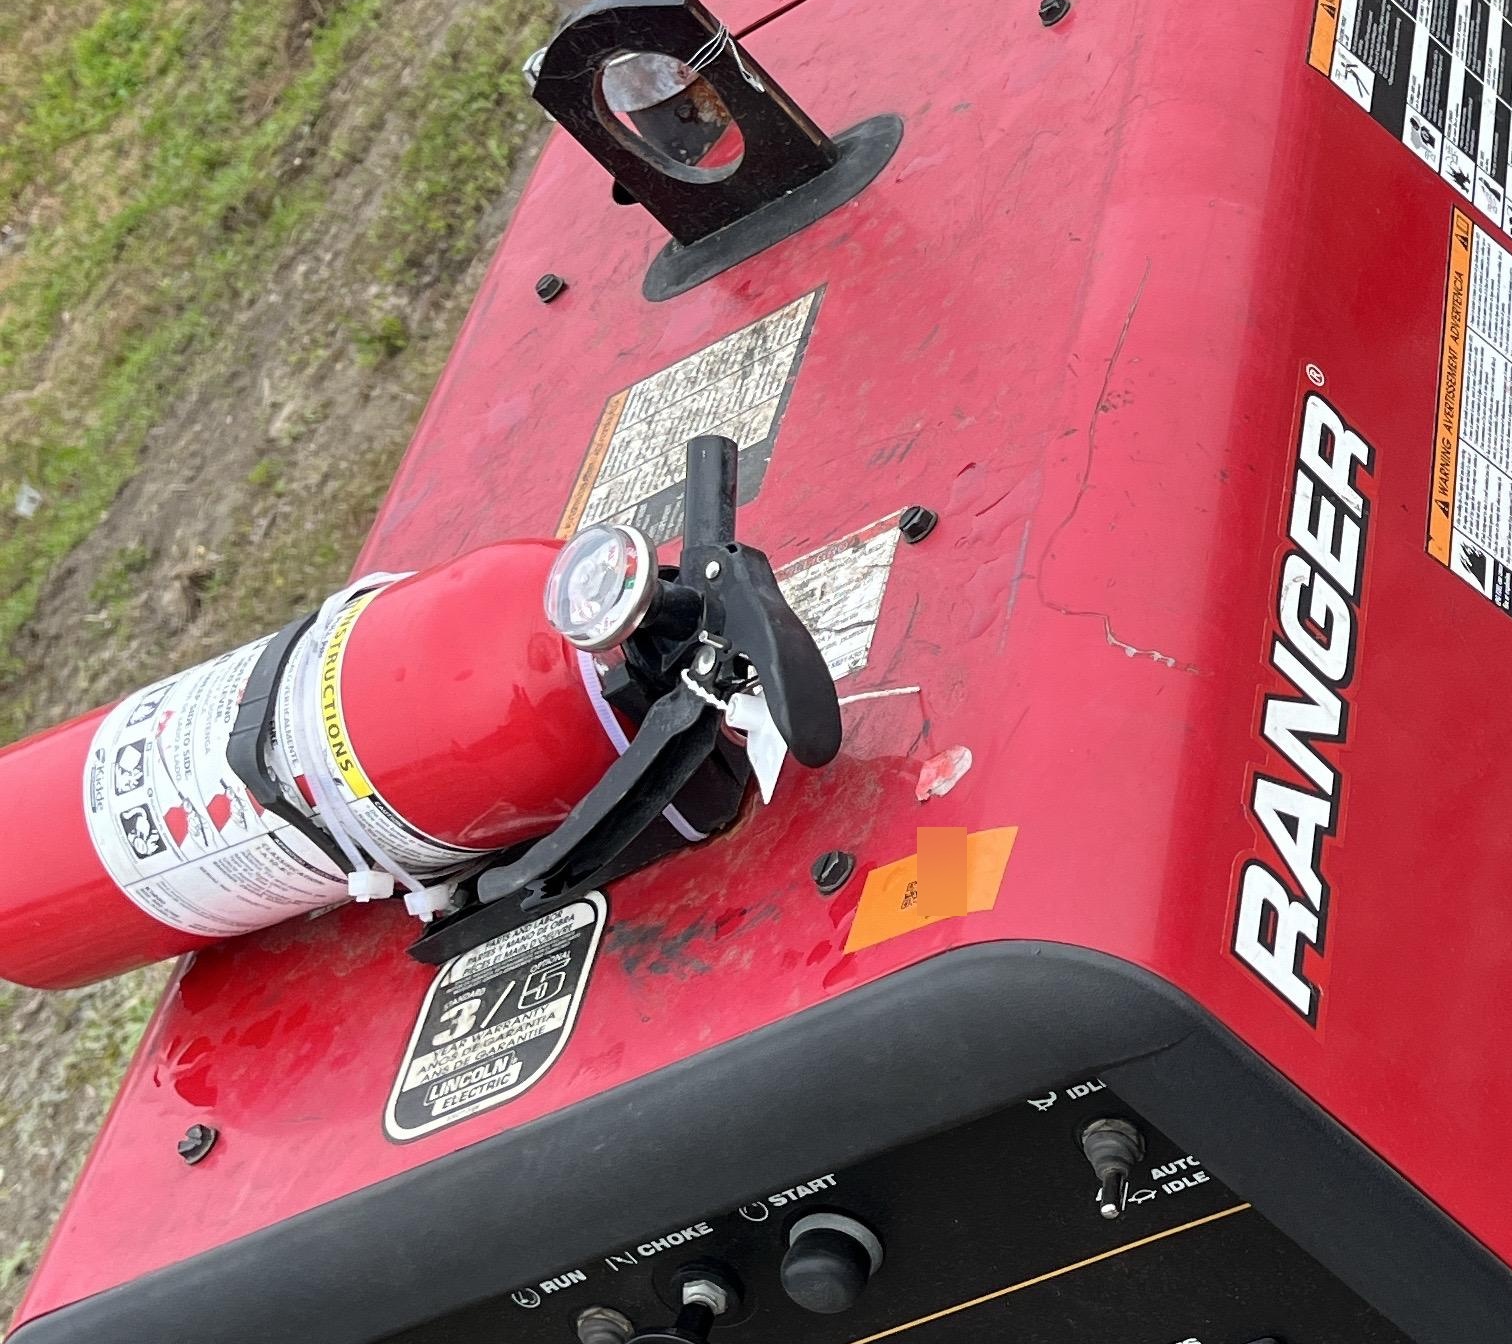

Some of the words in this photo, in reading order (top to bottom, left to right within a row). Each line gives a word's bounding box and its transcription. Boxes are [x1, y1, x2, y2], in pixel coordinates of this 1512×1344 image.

[1449, 271, 1465, 343] ADVERTENCIA
[1443, 346, 1459, 434] AVERTISSEMENT
[1438, 436, 1452, 497] WARNING
[433, 1036, 470, 1058] YEAR
[472, 1004, 551, 1039] WARRANTY
[459, 1043, 477, 1056] DE
[478, 1012, 556, 1047] GARANTIA
[420, 1067, 451, 1084] ANS
[454, 1059, 474, 1073] DE
[475, 1025, 547, 1060] GARANTIE
[428, 1055, 511, 1102] LINCOLN
[441, 1072, 512, 1109] ELECTRIC
[1065, 1077, 1108, 1100] IDL
[767, 1172, 838, 1208] START
[1161, 1170, 1211, 1195] IDLE
[636, 1221, 714, 1257] CHOKE
[538, 1268, 588, 1295] RUN
